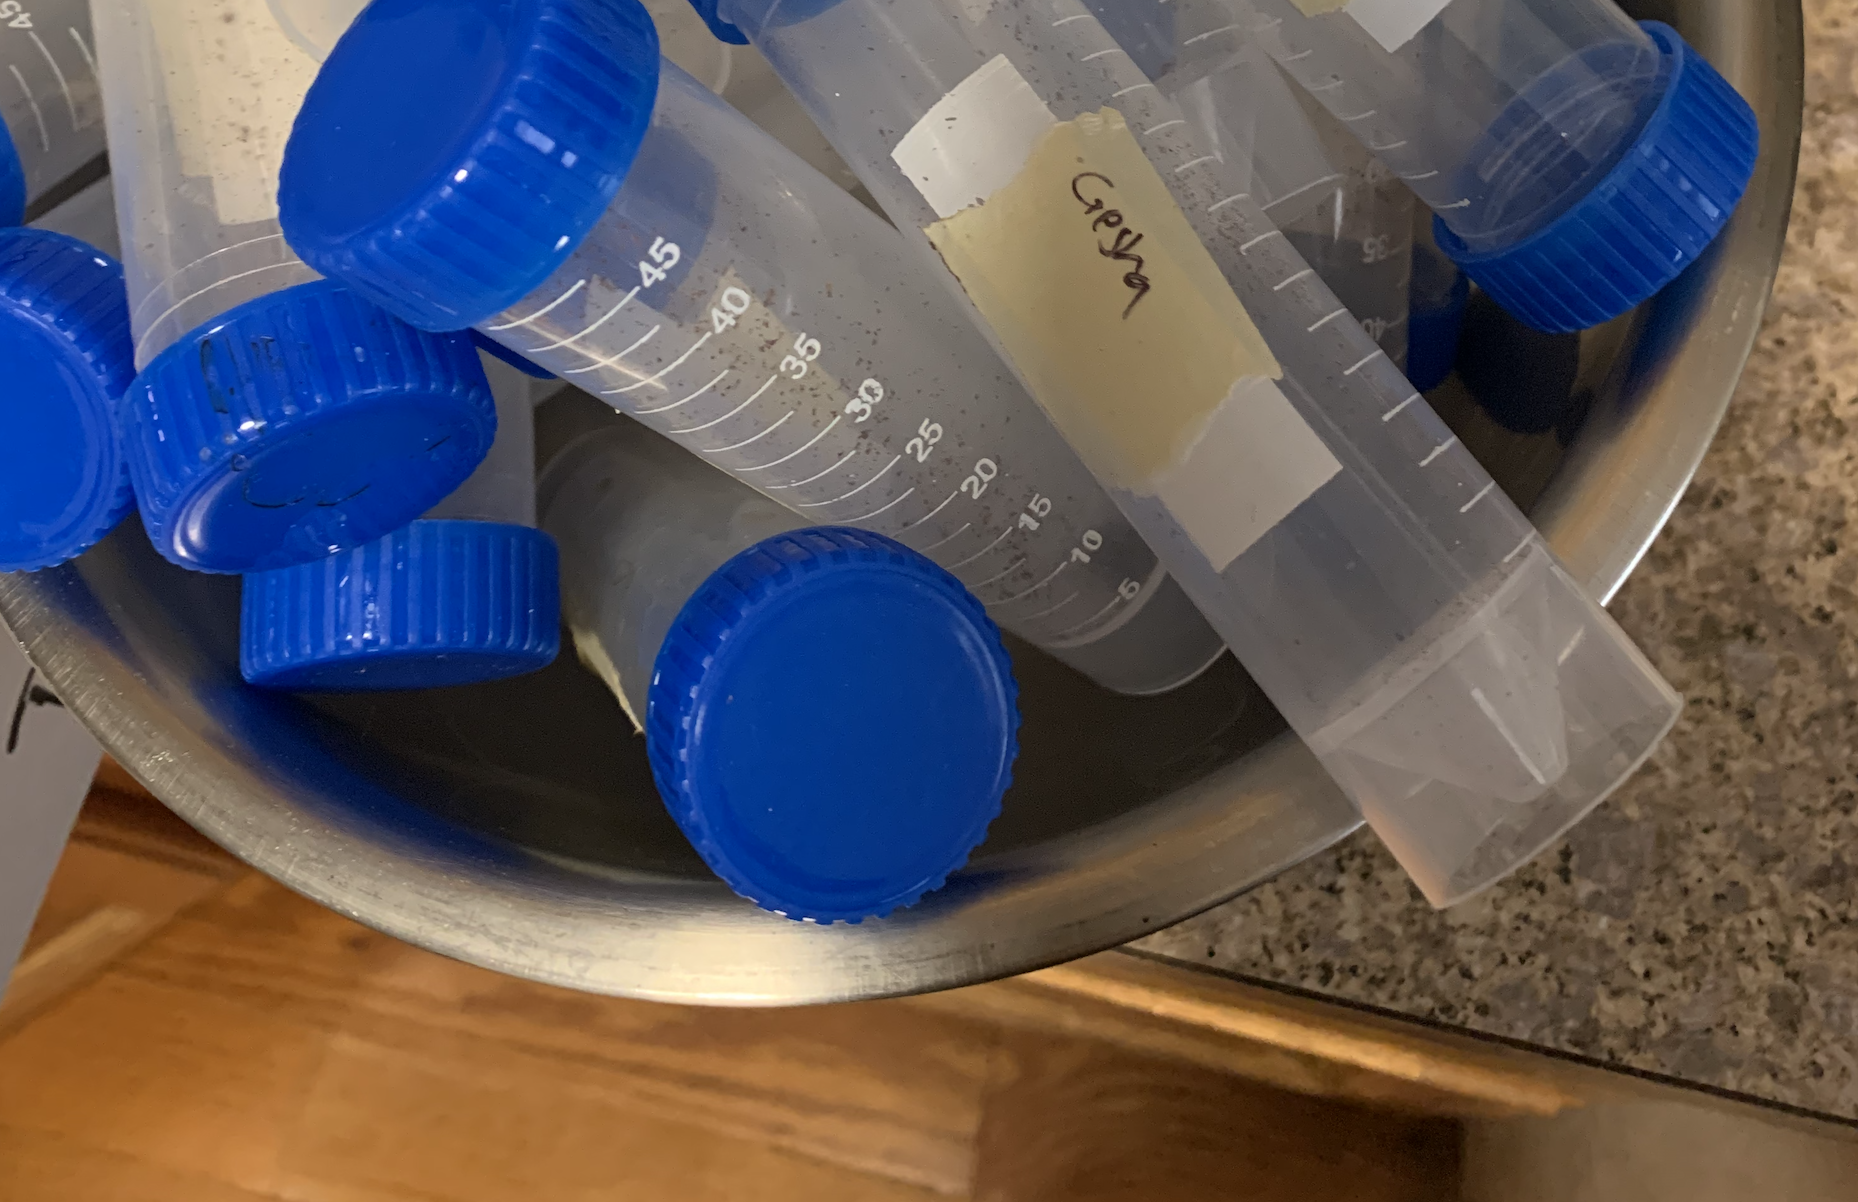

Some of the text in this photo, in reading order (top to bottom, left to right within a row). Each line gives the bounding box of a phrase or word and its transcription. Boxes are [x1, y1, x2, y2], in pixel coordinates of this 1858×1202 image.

[637, 236, 681, 289] 45
[1072, 171, 1150, 319] Gesha
[709, 285, 752, 337] 40
[779, 332, 822, 380] 35
[844, 377, 885, 424] 30
[905, 417, 944, 463] 25
[960, 457, 999, 500] 20
[1018, 493, 1053, 533] 15
[1070, 529, 1104, 567] 10
[1118, 577, 1142, 601] 5
